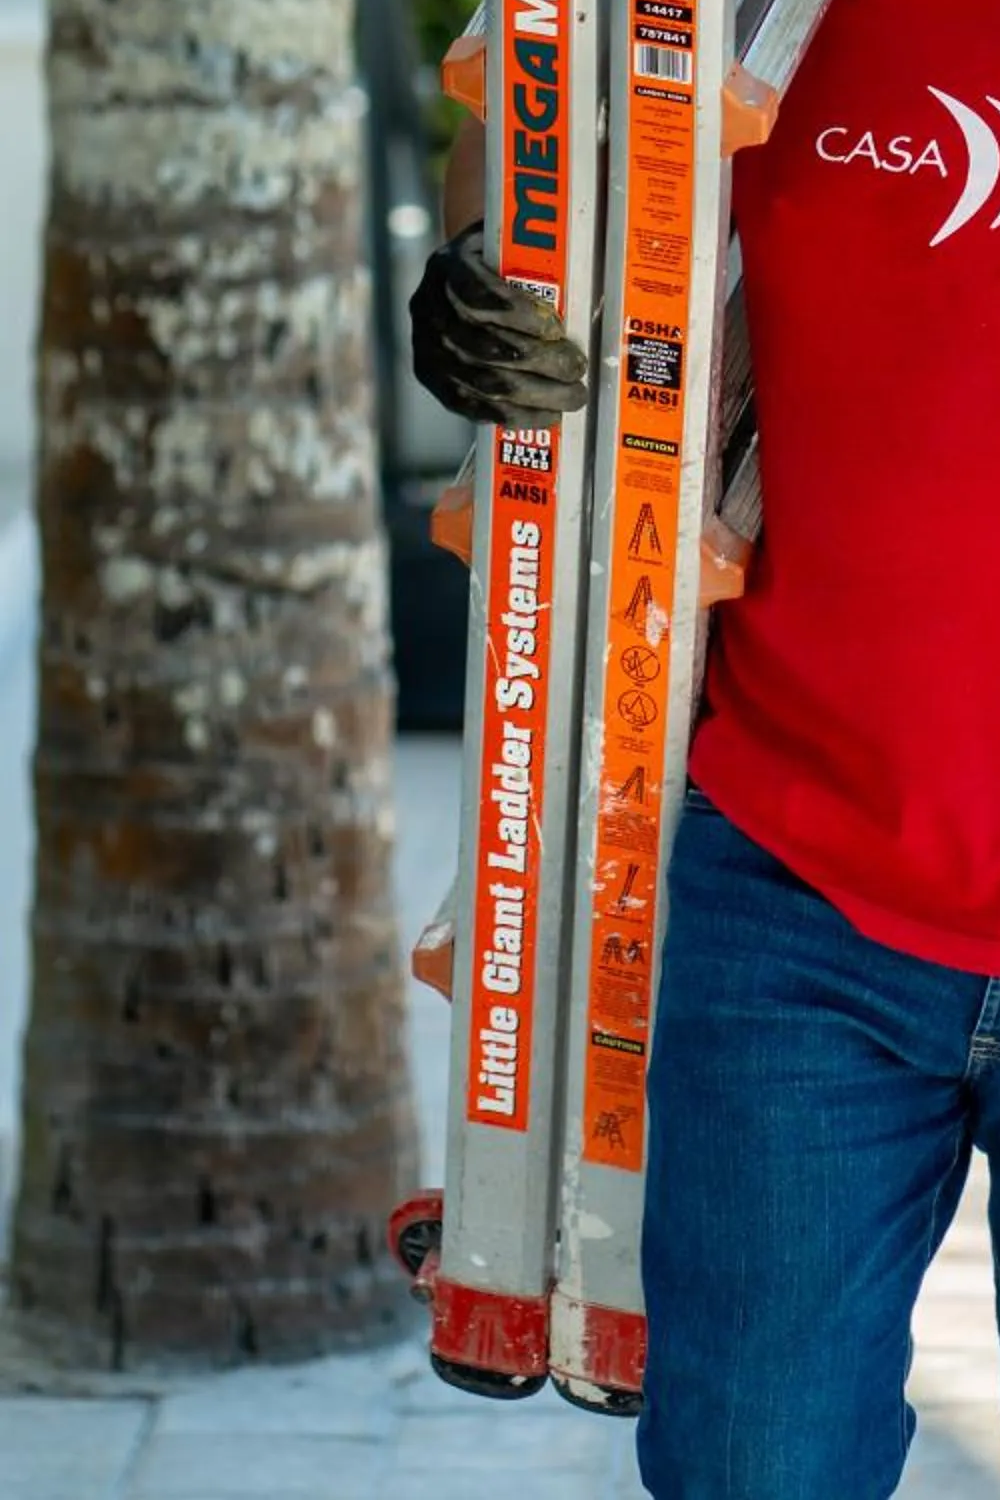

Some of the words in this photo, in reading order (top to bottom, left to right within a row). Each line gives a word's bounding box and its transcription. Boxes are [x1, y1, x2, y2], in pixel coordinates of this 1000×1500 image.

[815, 127, 948, 178] CASA
[630, 319, 681, 338] OSHA
[628, 386, 679, 407] ANSI
[503, 442, 549, 462] DUTY
[625, 438, 675, 454] CAUTION
[500, 480, 548, 506] ANSI
[495, 519, 541, 712] Systems
[487, 720, 533, 873] Ladder
[482, 883, 525, 995] Giant
[477, 1006, 520, 1117] Little
